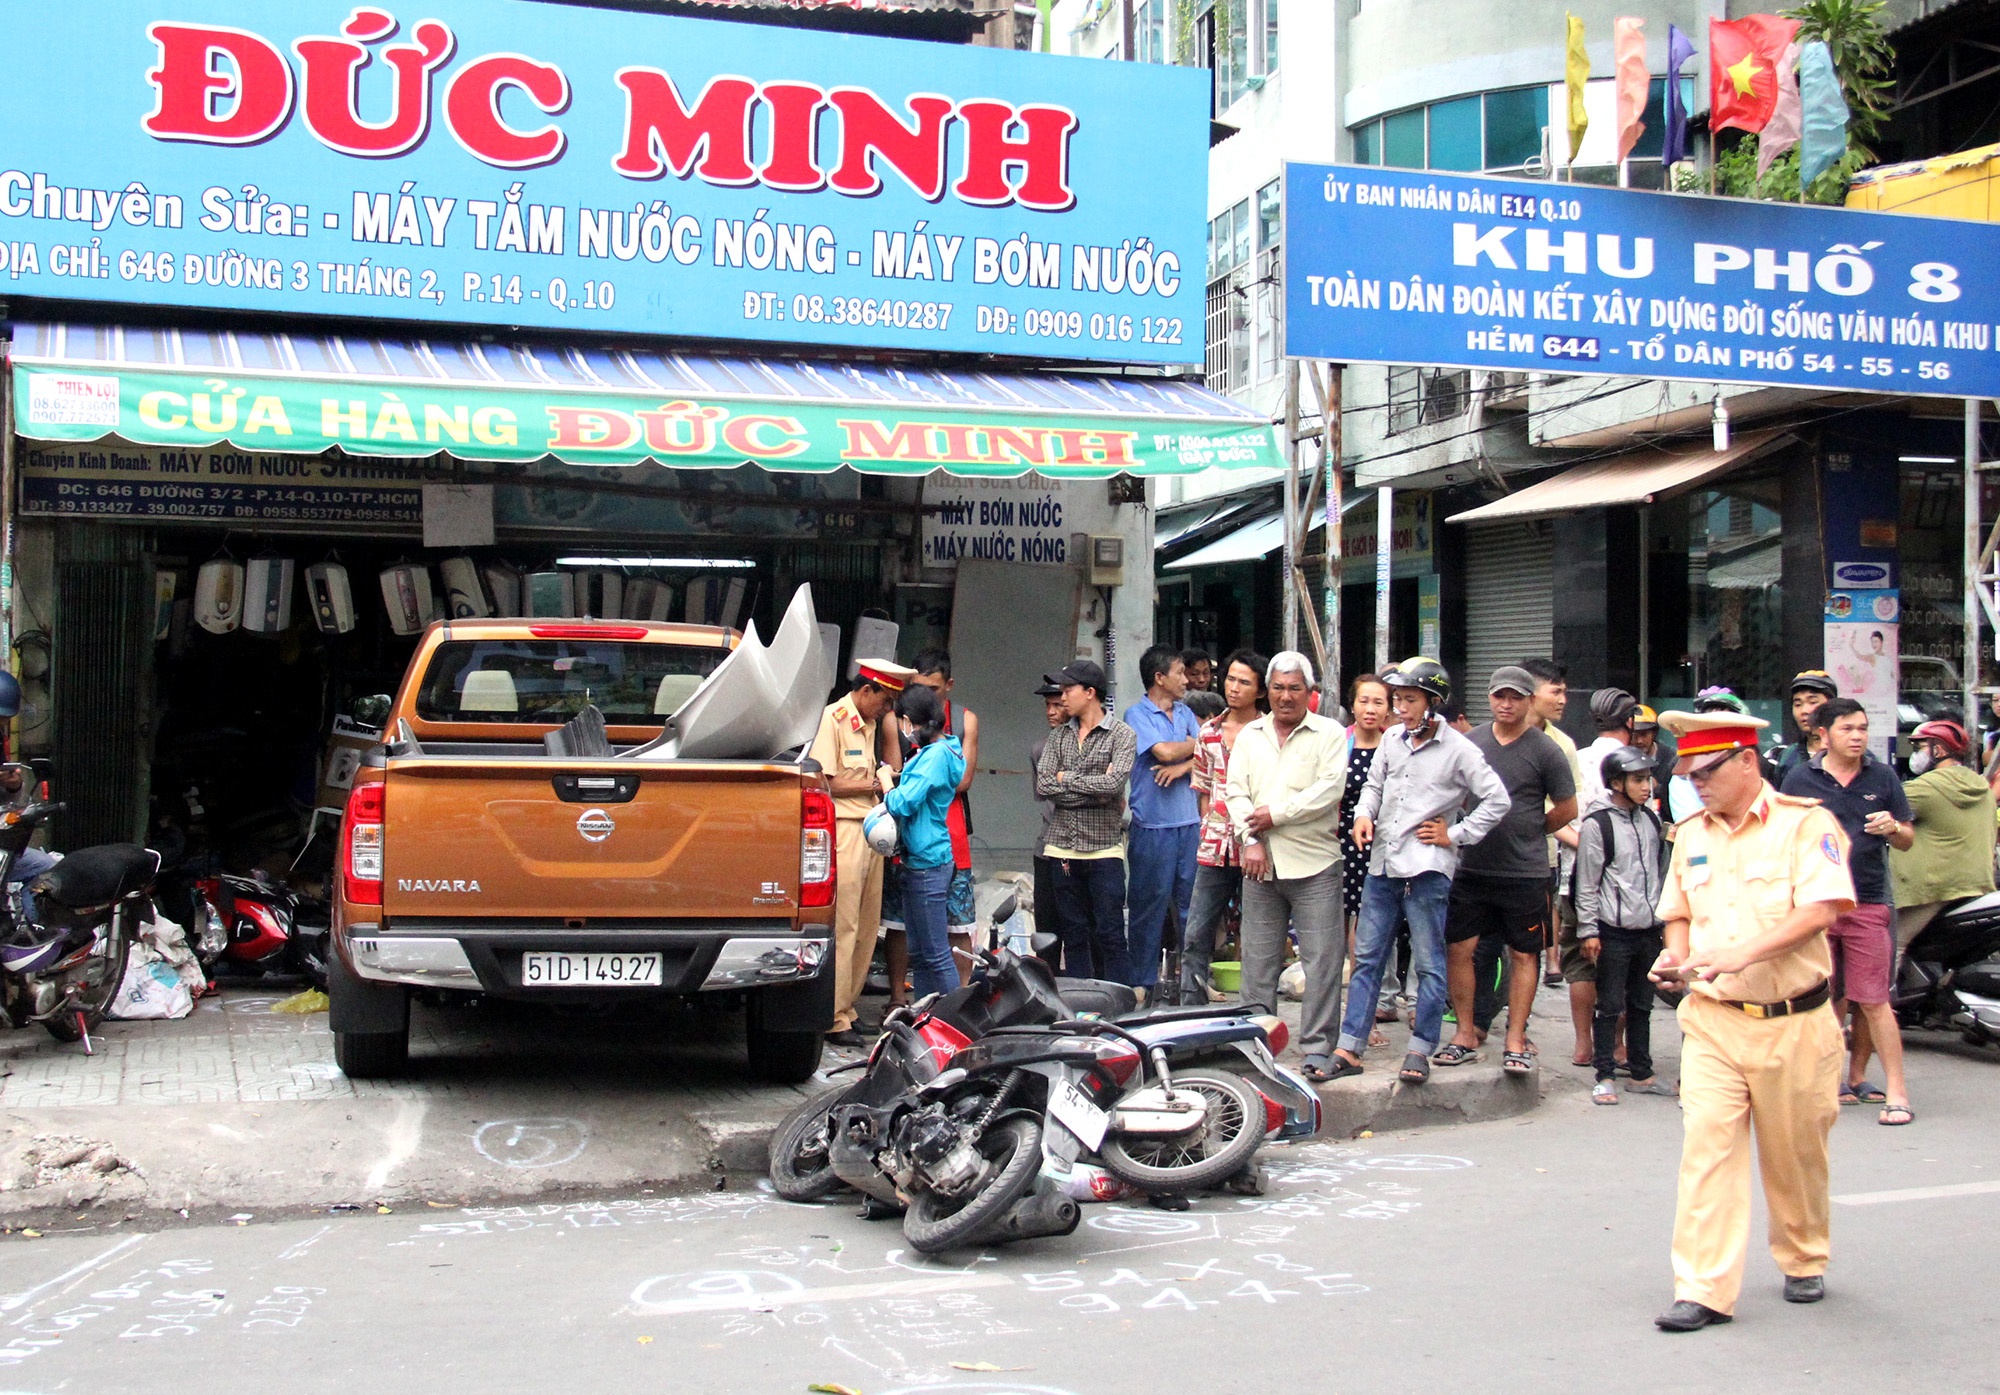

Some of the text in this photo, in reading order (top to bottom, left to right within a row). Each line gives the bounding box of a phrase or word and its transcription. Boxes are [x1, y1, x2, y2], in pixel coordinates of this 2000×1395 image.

[141, 7, 1079, 212] ĐỨC MINH
[1324, 173, 1352, 204] ỦY
[1356, 182, 1397, 208] BAN
[1400, 183, 1453, 211] NHÂN
[1457, 188, 1496, 214] DÂN
[1540, 198, 1581, 221] Q.10
[0, 170, 184, 235] Chuyên
[199, 184, 308, 238] Sửa:
[352, 182, 456, 246] MÁY
[467, 183, 565, 257] TẮM
[578, 199, 701, 266] NƯỚC
[714, 208, 837, 275] NÓNG
[872, 220, 963, 283] MÁY
[974, 233, 1060, 290] BƠM
[1072, 237, 1180, 298] NƯỚC
[1452, 223, 1962, 303] KHU PHỐ 8
[49, 237, 110, 280] CHỈ:
[118, 250, 175, 284] 646
[183, 250, 283, 291] ĐƯỜNG
[291, 261, 309, 291] 3
[317, 257, 412, 298] THÁNG
[419, 269, 446, 306] 2,
[462, 274, 523, 305] P.14
[548, 278, 616, 311] Q.10
[743, 291, 785, 321] ĐT:
[792, 294, 954, 332] 08.38640287
[976, 305, 1017, 334] DĐ:
[1023, 310, 1083, 340] 0909
[1089, 313, 1133, 343] 016
[1140, 316, 1183, 346] 122
[1307, 269, 1989, 351] TOÀN DÂN ĐOÀN KẾT XÂY DỰNG ĐỜI SỐNG VĂN HÓA KHU
[1467, 325, 1534, 354] HẺM
[1544, 336, 1598, 358] 644
[1627, 333, 1665, 358] TỔ
[1674, 341, 1728, 364] DÂN
[1739, 344, 1796, 371] PHỐ
[1803, 354, 1835, 373] 54
[1861, 357, 1892, 376] 55
[1918, 361, 1950, 380] 56
[138, 378, 1146, 468] CỬA HÀNG ĐỨC MINH
[160, 448, 202, 474] MÁY
[97, 485, 132, 497] 646
[980, 497, 1014, 527] BƠM
[1018, 495, 1063, 527] NƯỚC
[933, 531, 968, 561] MÁY
[1021, 533, 1066, 563] NÓNG
[397, 878, 481, 893] NAVARA
[761, 882, 786, 894] EL
[527, 955, 658, 983] 51D-149.27
